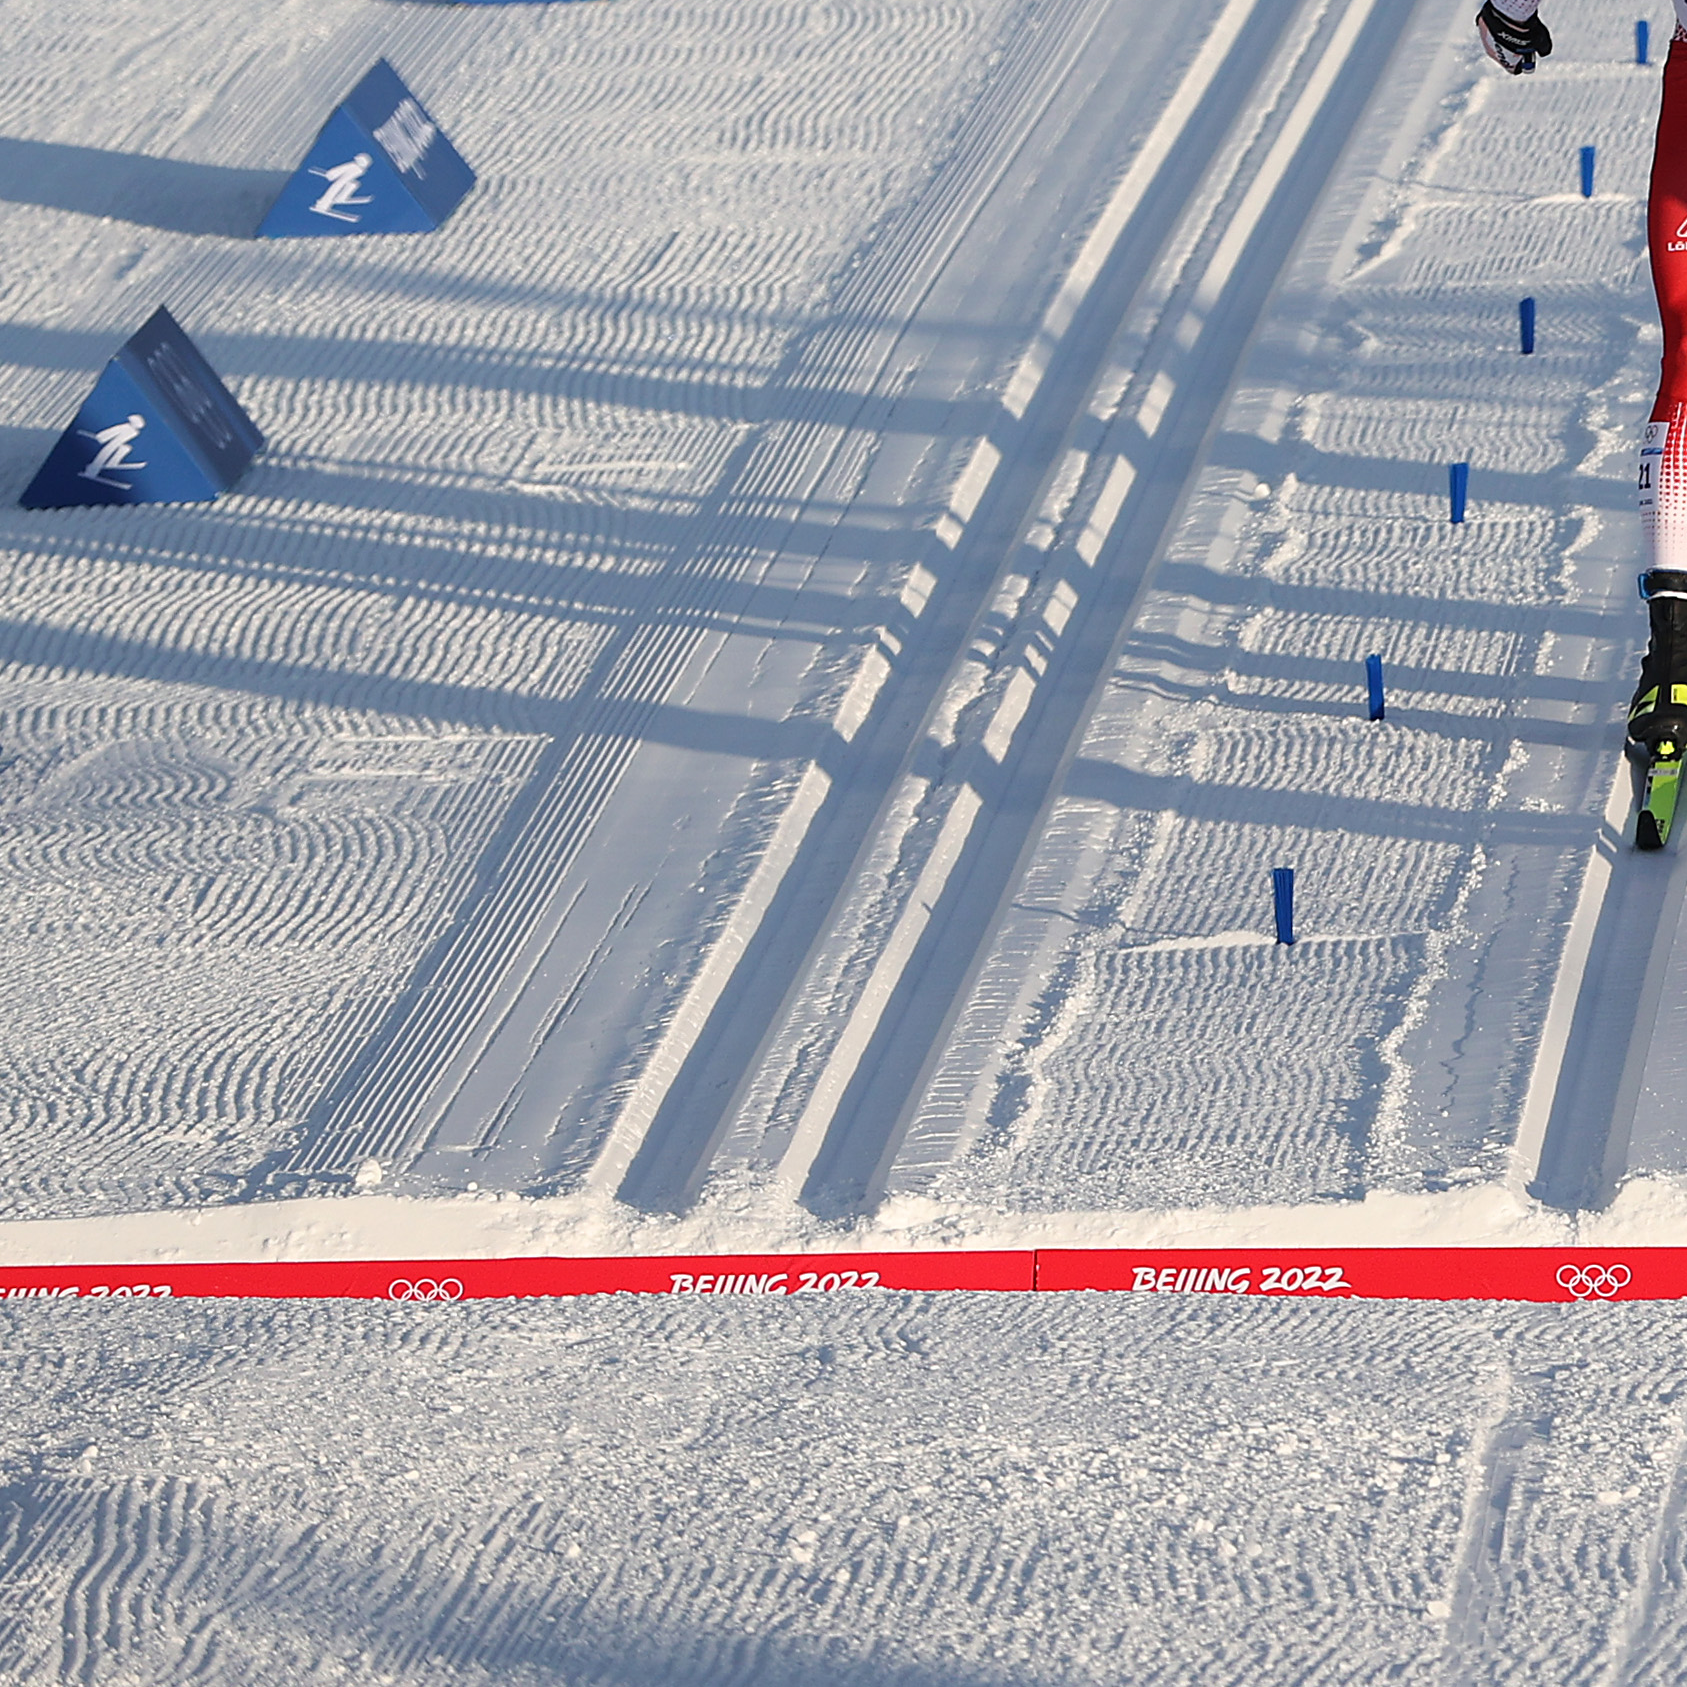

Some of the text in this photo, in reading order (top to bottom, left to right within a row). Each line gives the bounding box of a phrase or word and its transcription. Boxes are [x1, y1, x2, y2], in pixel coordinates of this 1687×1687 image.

[670, 1274, 789, 1294] BEIJING
[1132, 1266, 1353, 1294] BEIJING 2022
